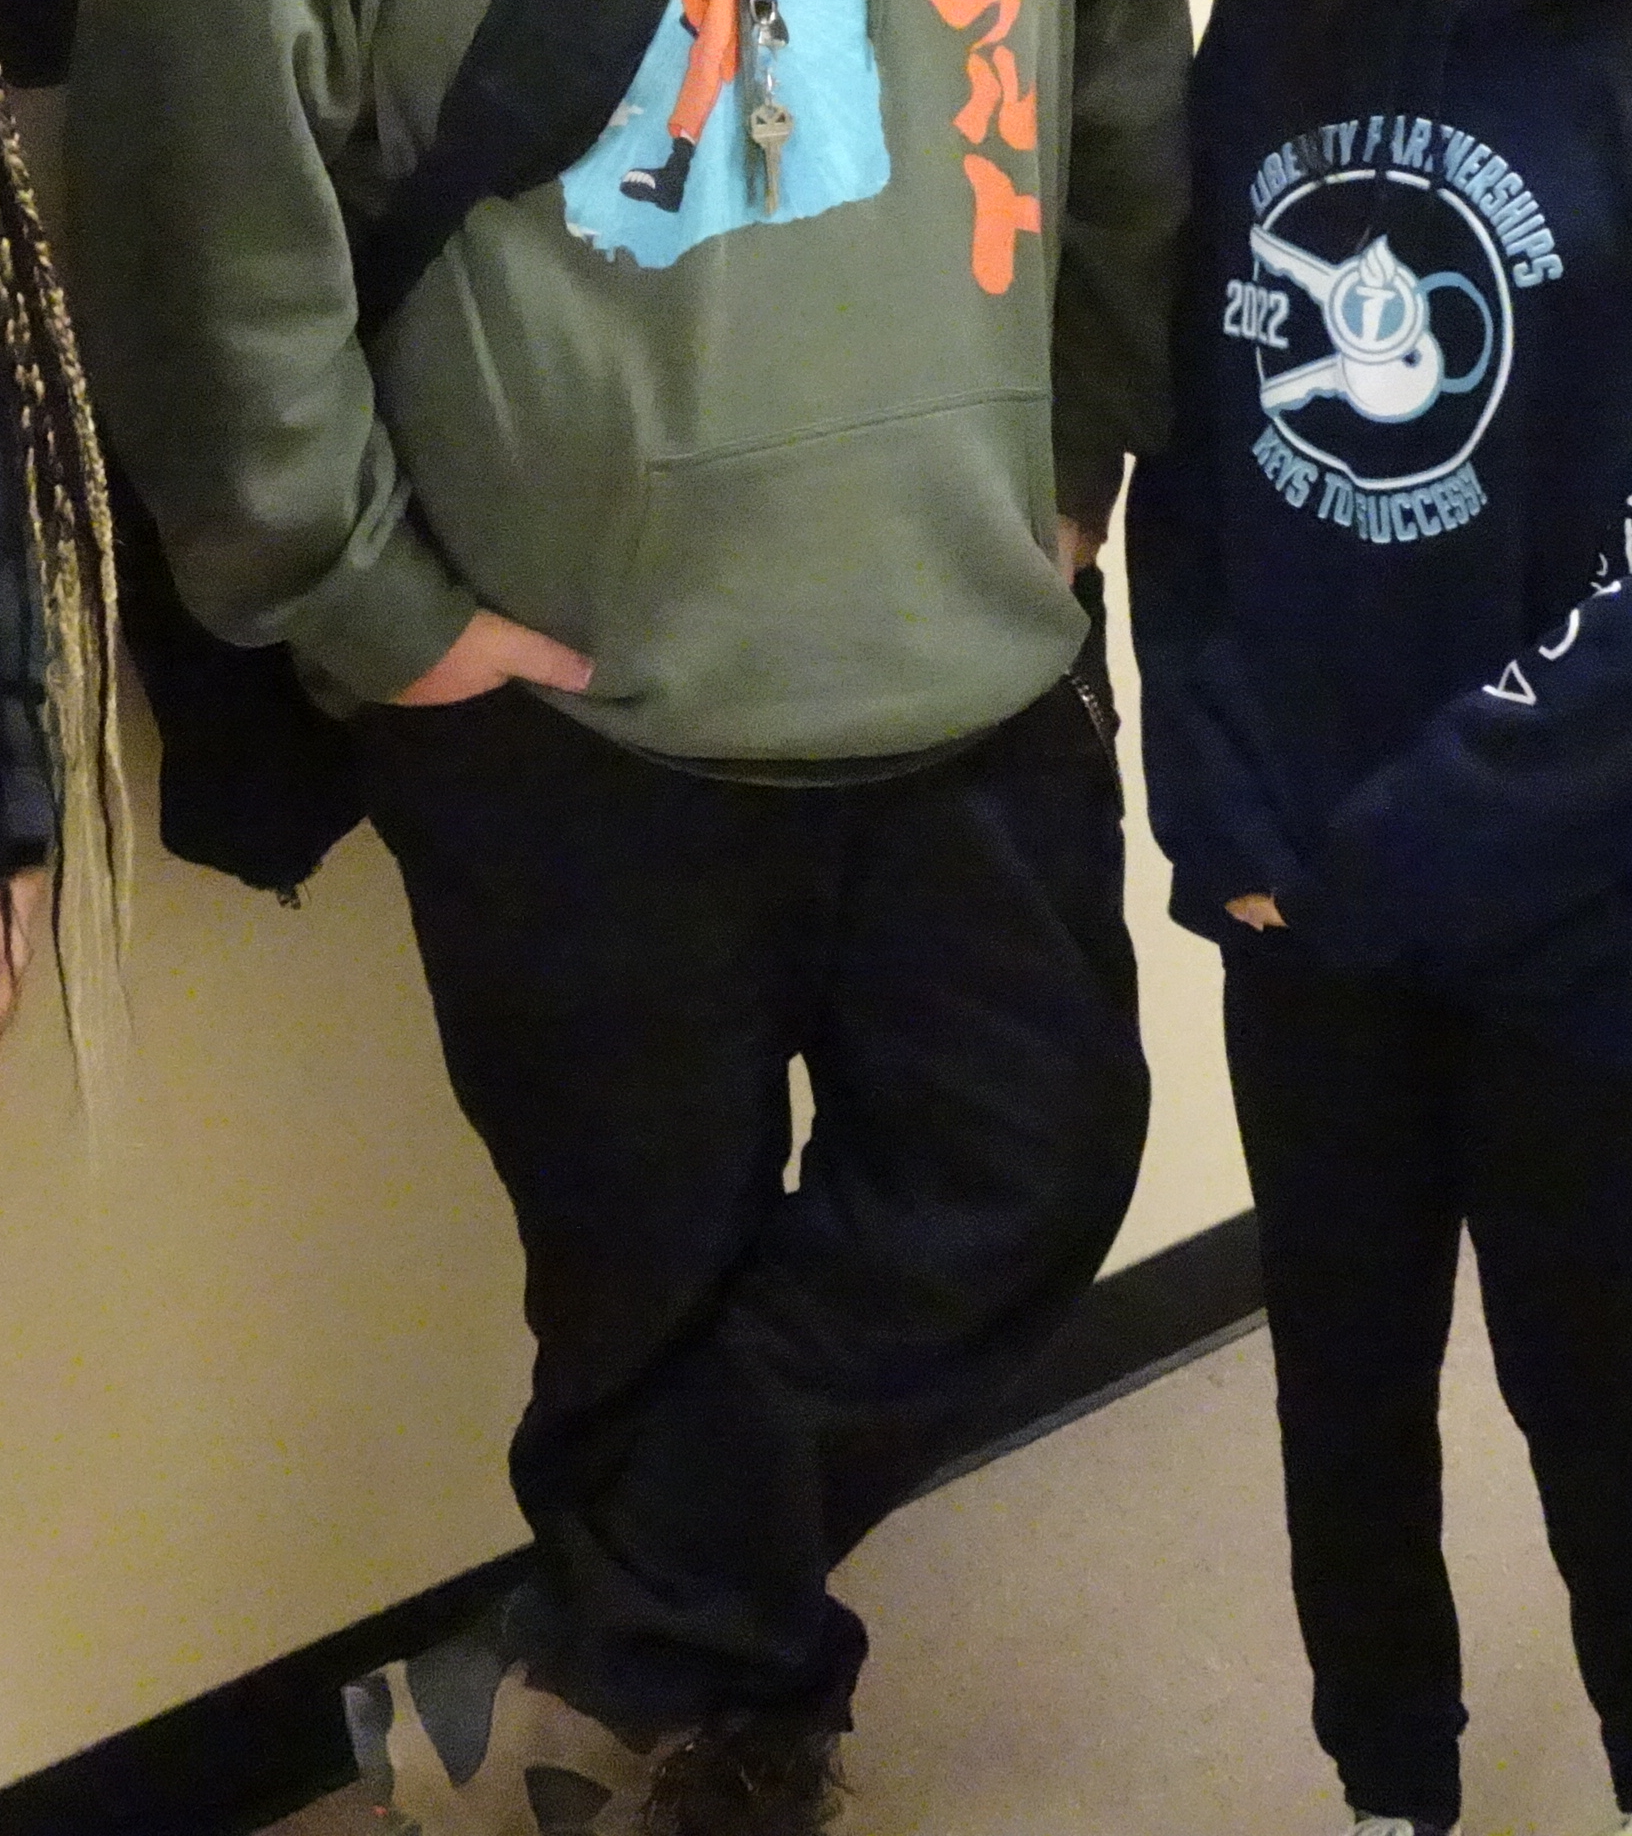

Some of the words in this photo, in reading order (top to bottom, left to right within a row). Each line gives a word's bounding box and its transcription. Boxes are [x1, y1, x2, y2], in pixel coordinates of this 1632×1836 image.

[1222, 278, 1291, 350] 2022
[1252, 423, 1319, 509] KEYS
[1316, 471, 1355, 528] TO
